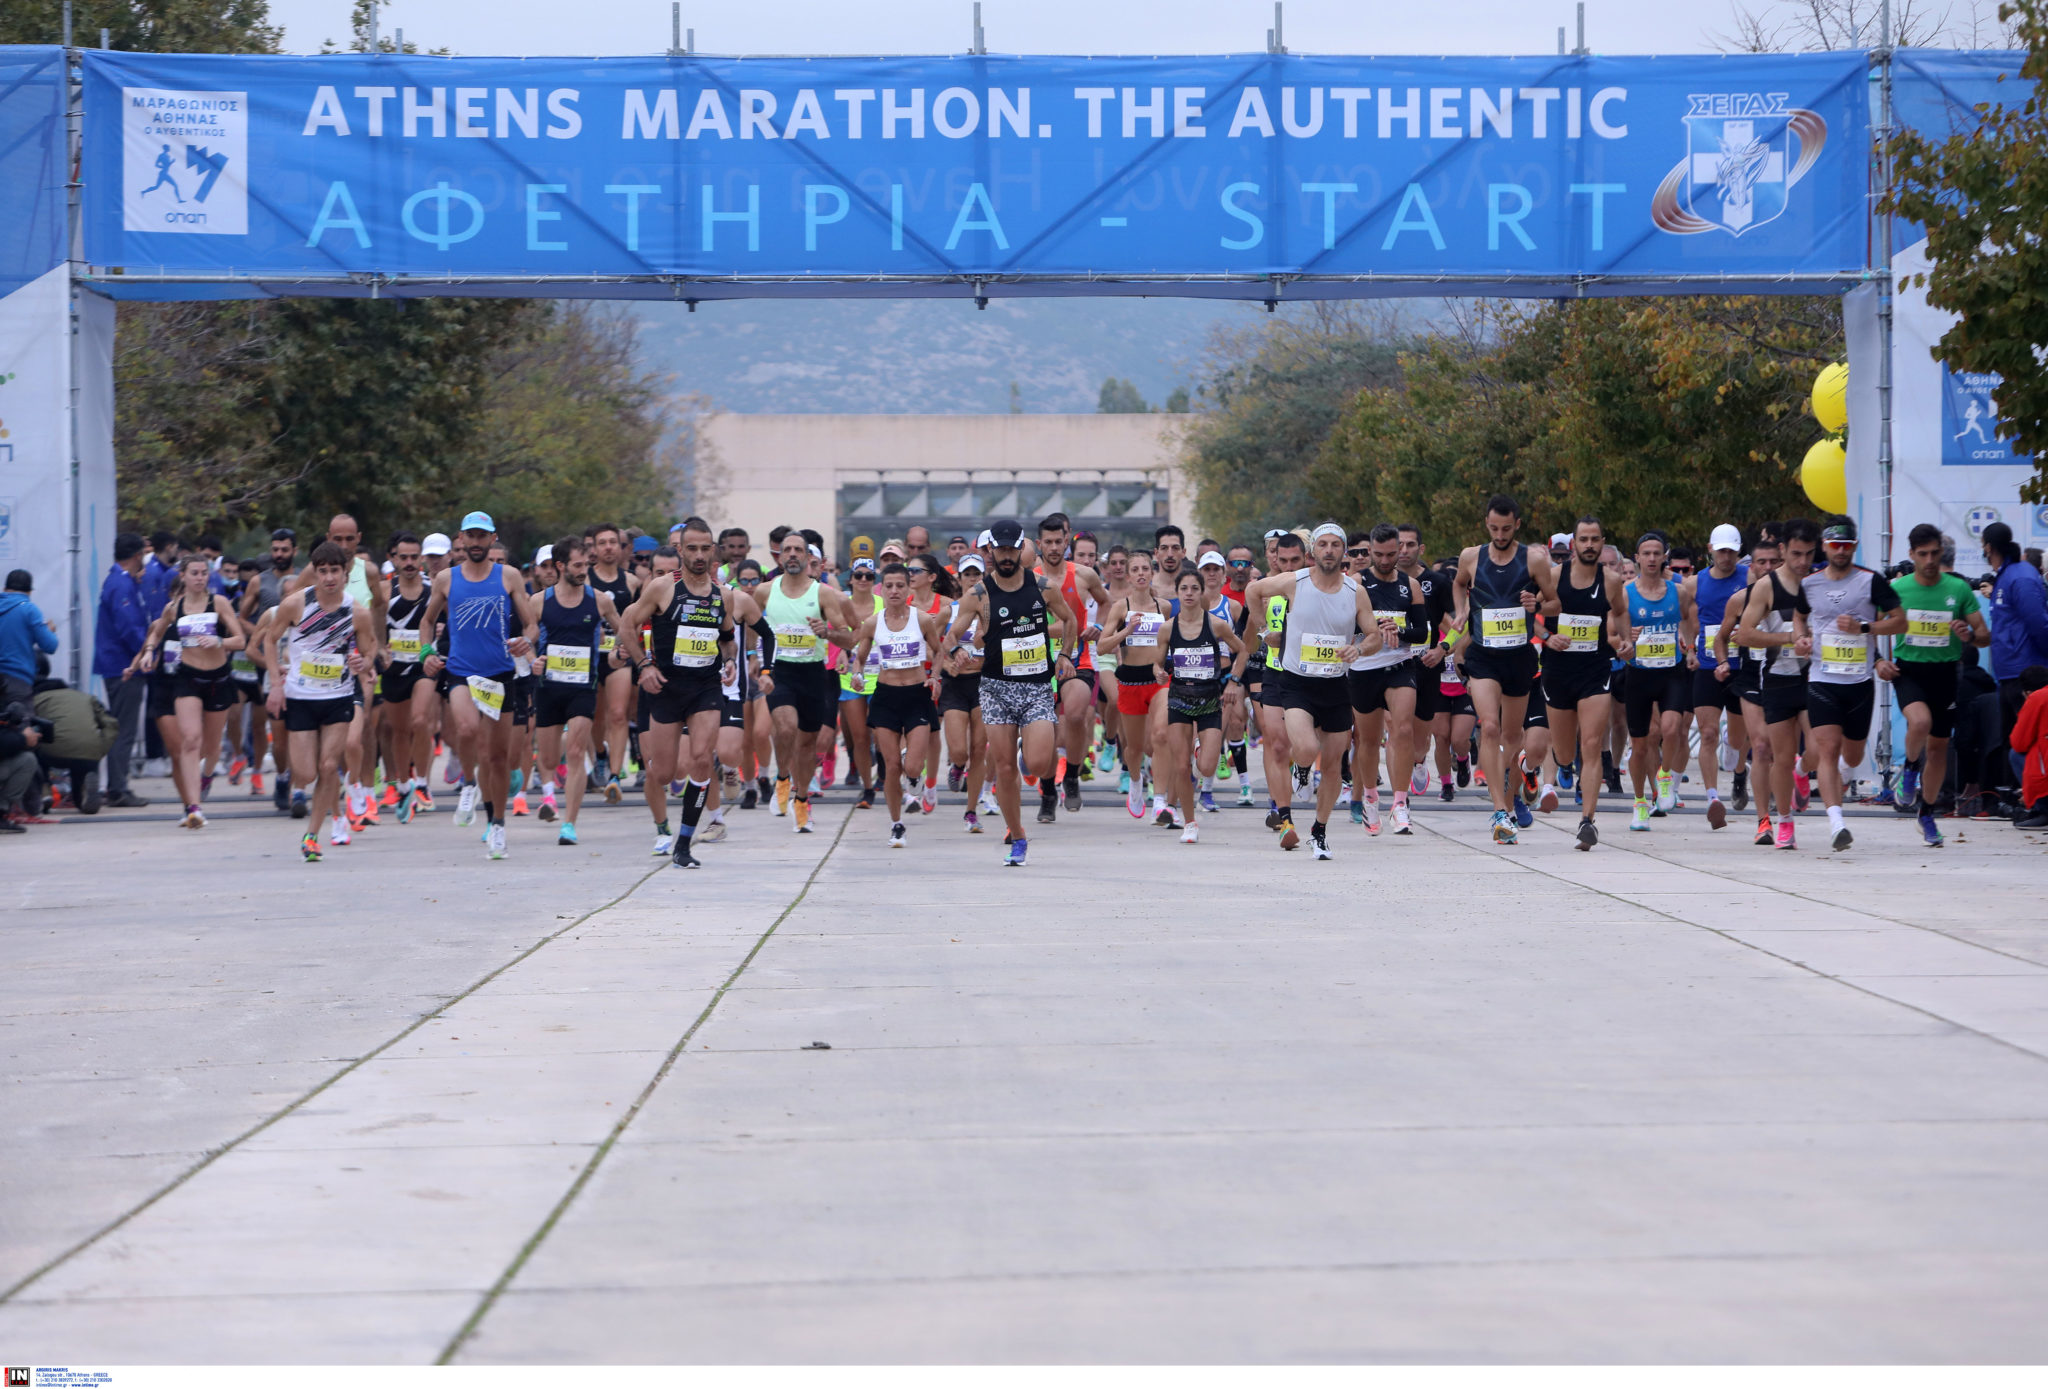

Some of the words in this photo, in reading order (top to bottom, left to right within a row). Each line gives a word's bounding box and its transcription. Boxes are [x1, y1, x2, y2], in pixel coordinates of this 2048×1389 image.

[132, 97, 238, 112] ΜΑΡΑΘΩΝΙΟΣ
[1687, 92, 1789, 117] ΣΕΓΑΣ
[302, 85, 583, 139] ATHENS
[621, 86, 1052, 140] MARATHON.
[1073, 87, 1207, 138] THE
[1227, 86, 1628, 139] AUTHENTIC
[152, 112, 218, 125] ΑΘΗΝΑΣ
[156, 128, 226, 137] ΑΥΘΕΝΤΙΚΟΣ
[305, 181, 1010, 251] ΑΦΕΤΗΡΙΑ
[1221, 181, 1627, 251] START
[688, 614, 716, 623] balance
[1013, 623, 1036, 634] PROTEIN
[1138, 622, 1153, 631] 207
[1496, 621, 1513, 631] 104
[1921, 622, 1938, 632] 116
[1571, 627, 1587, 637] 113
[787, 635, 803, 644] 137
[691, 640, 708, 651] 103
[891, 644, 908, 654] 204
[1649, 645, 1664, 654] 130
[1018, 649, 1035, 659] 101
[1316, 648, 1334, 658] 149
[1835, 647, 1853, 658] 110
[560, 657, 576, 667] 108
[1185, 655, 1202, 665] 209
[314, 665, 330, 675] 112
